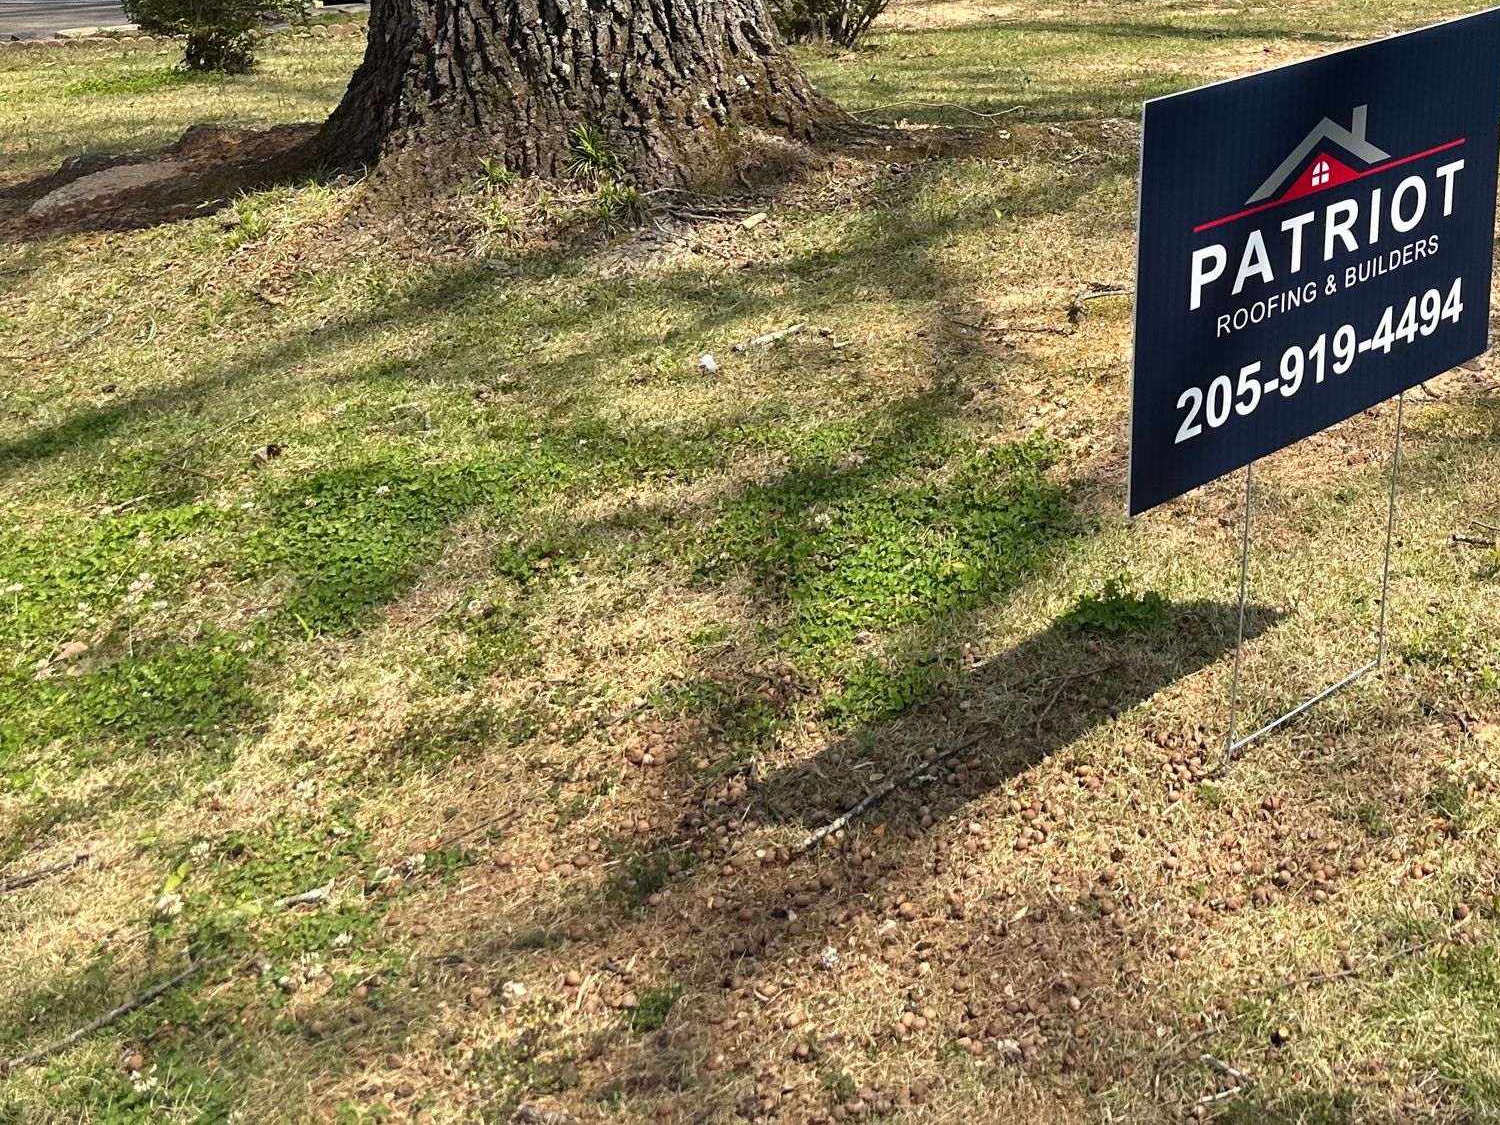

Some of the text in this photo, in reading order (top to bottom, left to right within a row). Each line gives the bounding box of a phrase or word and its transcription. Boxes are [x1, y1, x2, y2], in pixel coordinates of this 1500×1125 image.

[1189, 159, 1465, 311] PATRIOT
[1216, 235, 1439, 338] ROOFING & BUILDERS
[1175, 277, 1464, 444] 205-919-4494
